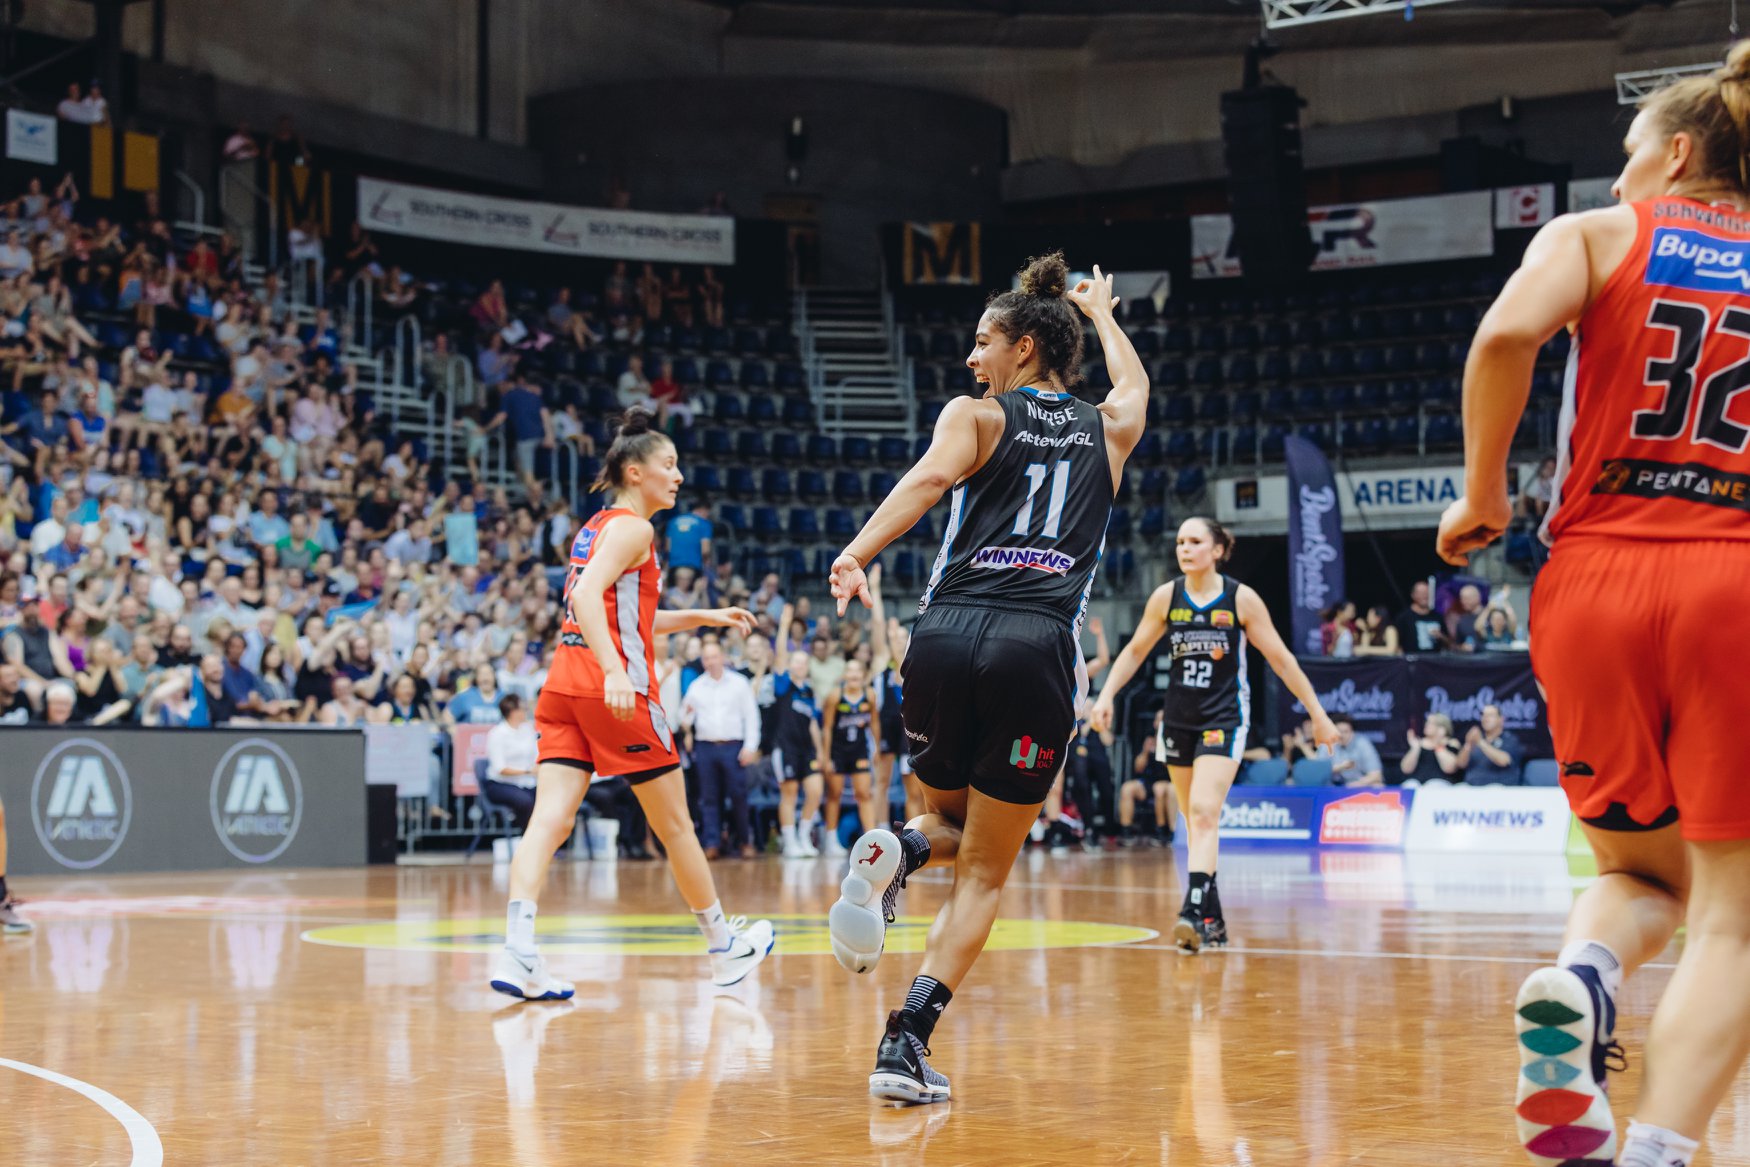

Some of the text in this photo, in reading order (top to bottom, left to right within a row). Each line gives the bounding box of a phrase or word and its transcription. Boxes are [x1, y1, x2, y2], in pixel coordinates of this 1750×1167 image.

[1655, 233, 1744, 268] Bupa
[1630, 298, 1750, 454] 32
[1026, 400, 1079, 427] NURSE
[1014, 430, 1095, 448] ActewAGL
[1010, 459, 1073, 540] 11
[1354, 478, 1458, 507] ARENA
[1182, 659, 1214, 689] 22
[1038, 747, 1055, 760] hit
